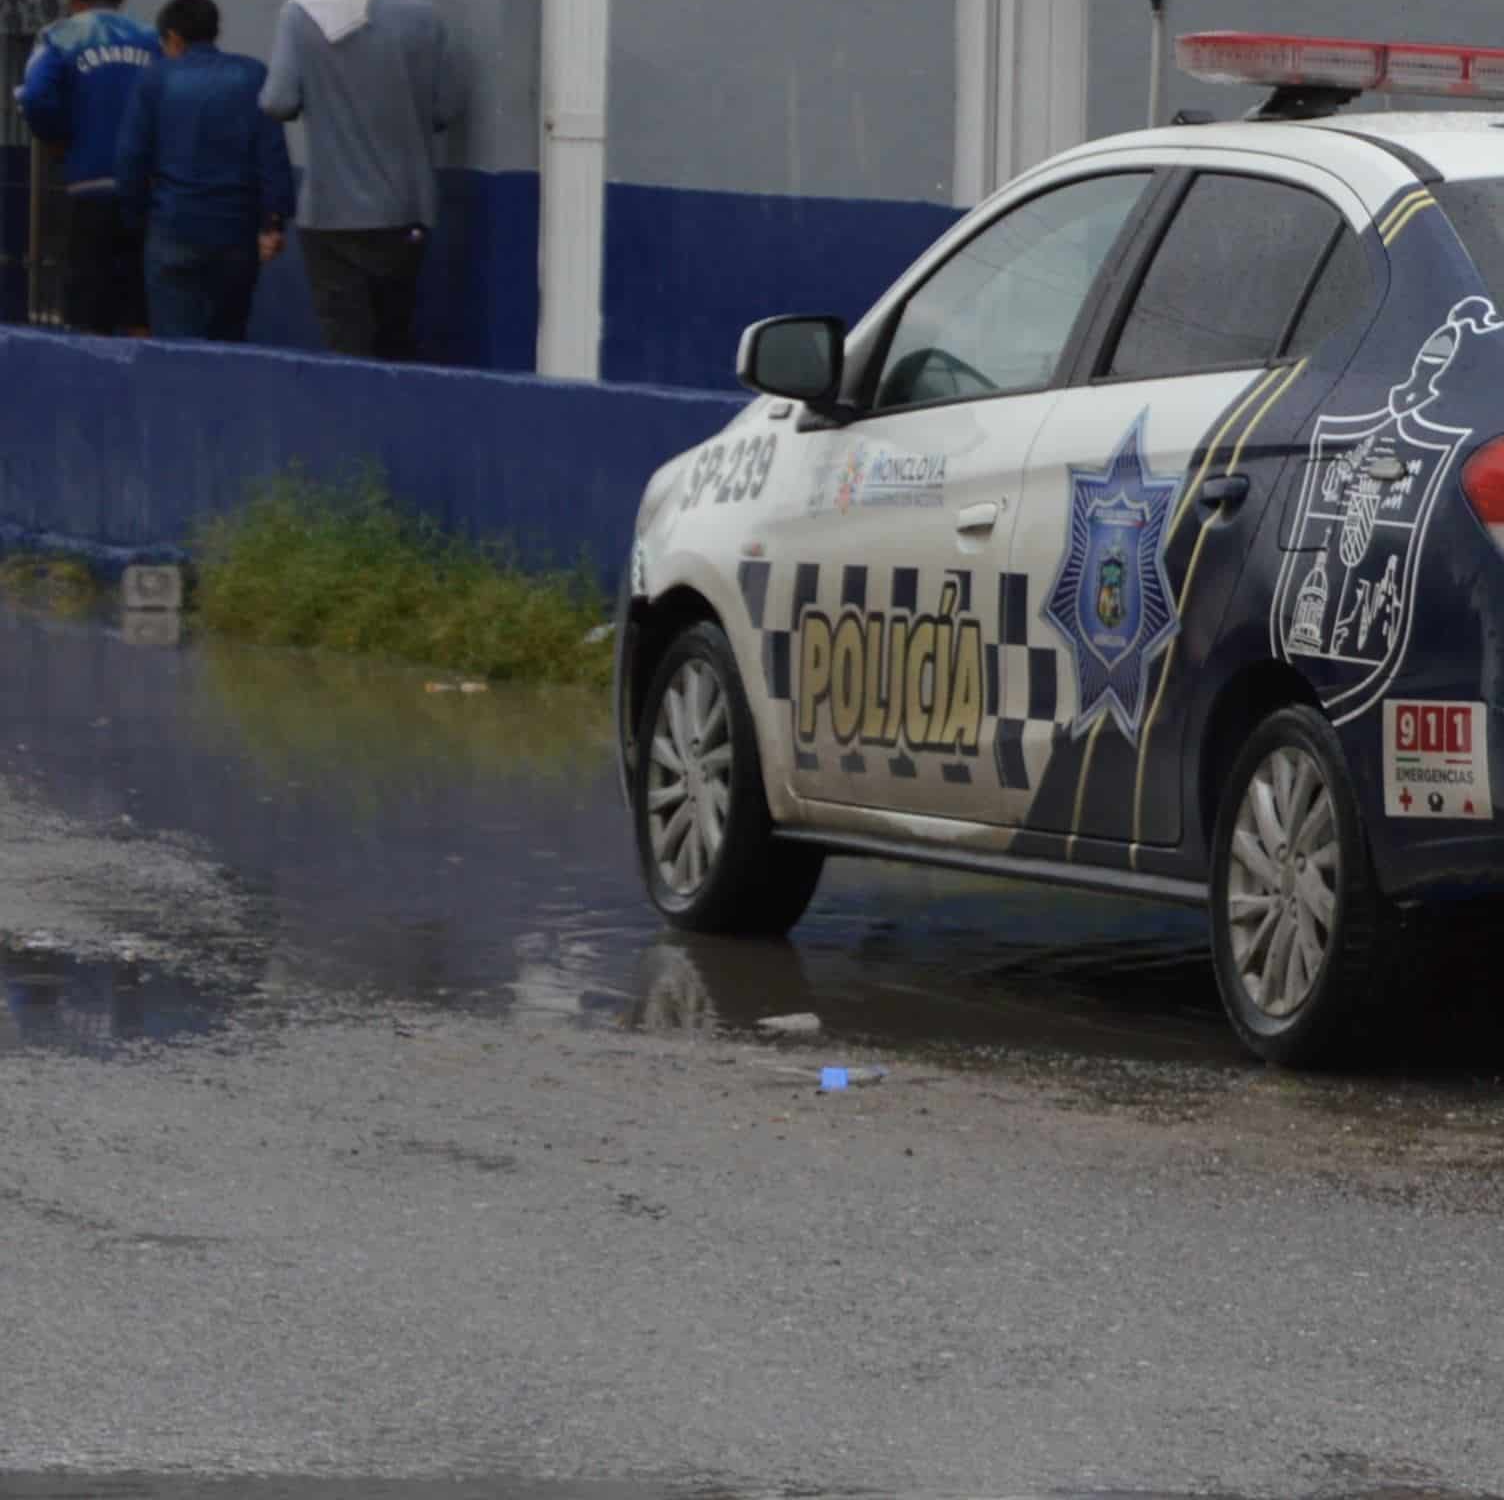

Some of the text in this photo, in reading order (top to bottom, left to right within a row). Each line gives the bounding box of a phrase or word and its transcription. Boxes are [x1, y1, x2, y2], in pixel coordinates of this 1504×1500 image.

[679, 433, 778, 512] SP-239
[799, 580, 984, 755] POLICÍA
[1398, 710, 1466, 749] 911
[1396, 768, 1473, 785] EMERGENCIAS
